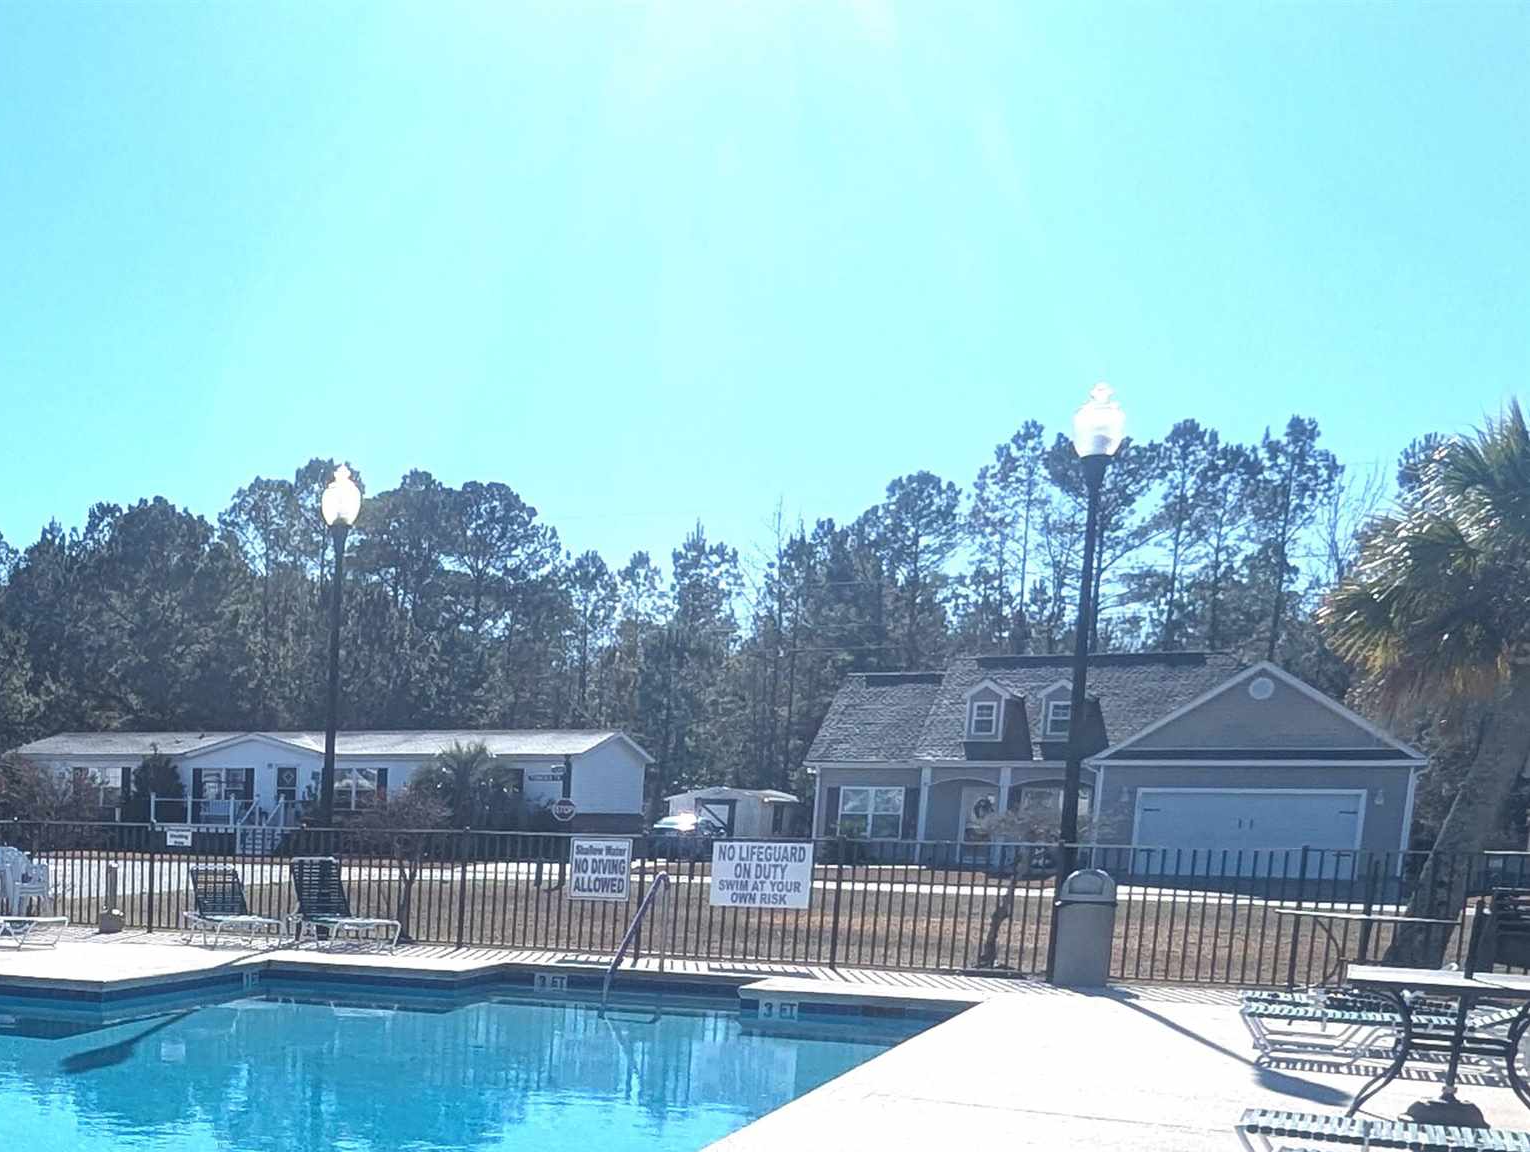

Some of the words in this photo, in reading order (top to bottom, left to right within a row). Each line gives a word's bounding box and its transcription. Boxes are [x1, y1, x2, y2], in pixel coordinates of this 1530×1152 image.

[718, 845, 736, 861] NO
[738, 845, 806, 863] LIFEGUARD
[573, 857, 589, 874] NO
[591, 858, 626, 875] DIVING
[734, 863, 751, 879] ON
[754, 863, 788, 880] DUTY
[573, 876, 625, 893] ALLOWED
[718, 879, 748, 891] SWIM
[751, 881, 766, 892] AT
[770, 881, 802, 893] YOUR
[730, 892, 757, 904] OWN
[759, 893, 787, 905] RISK
